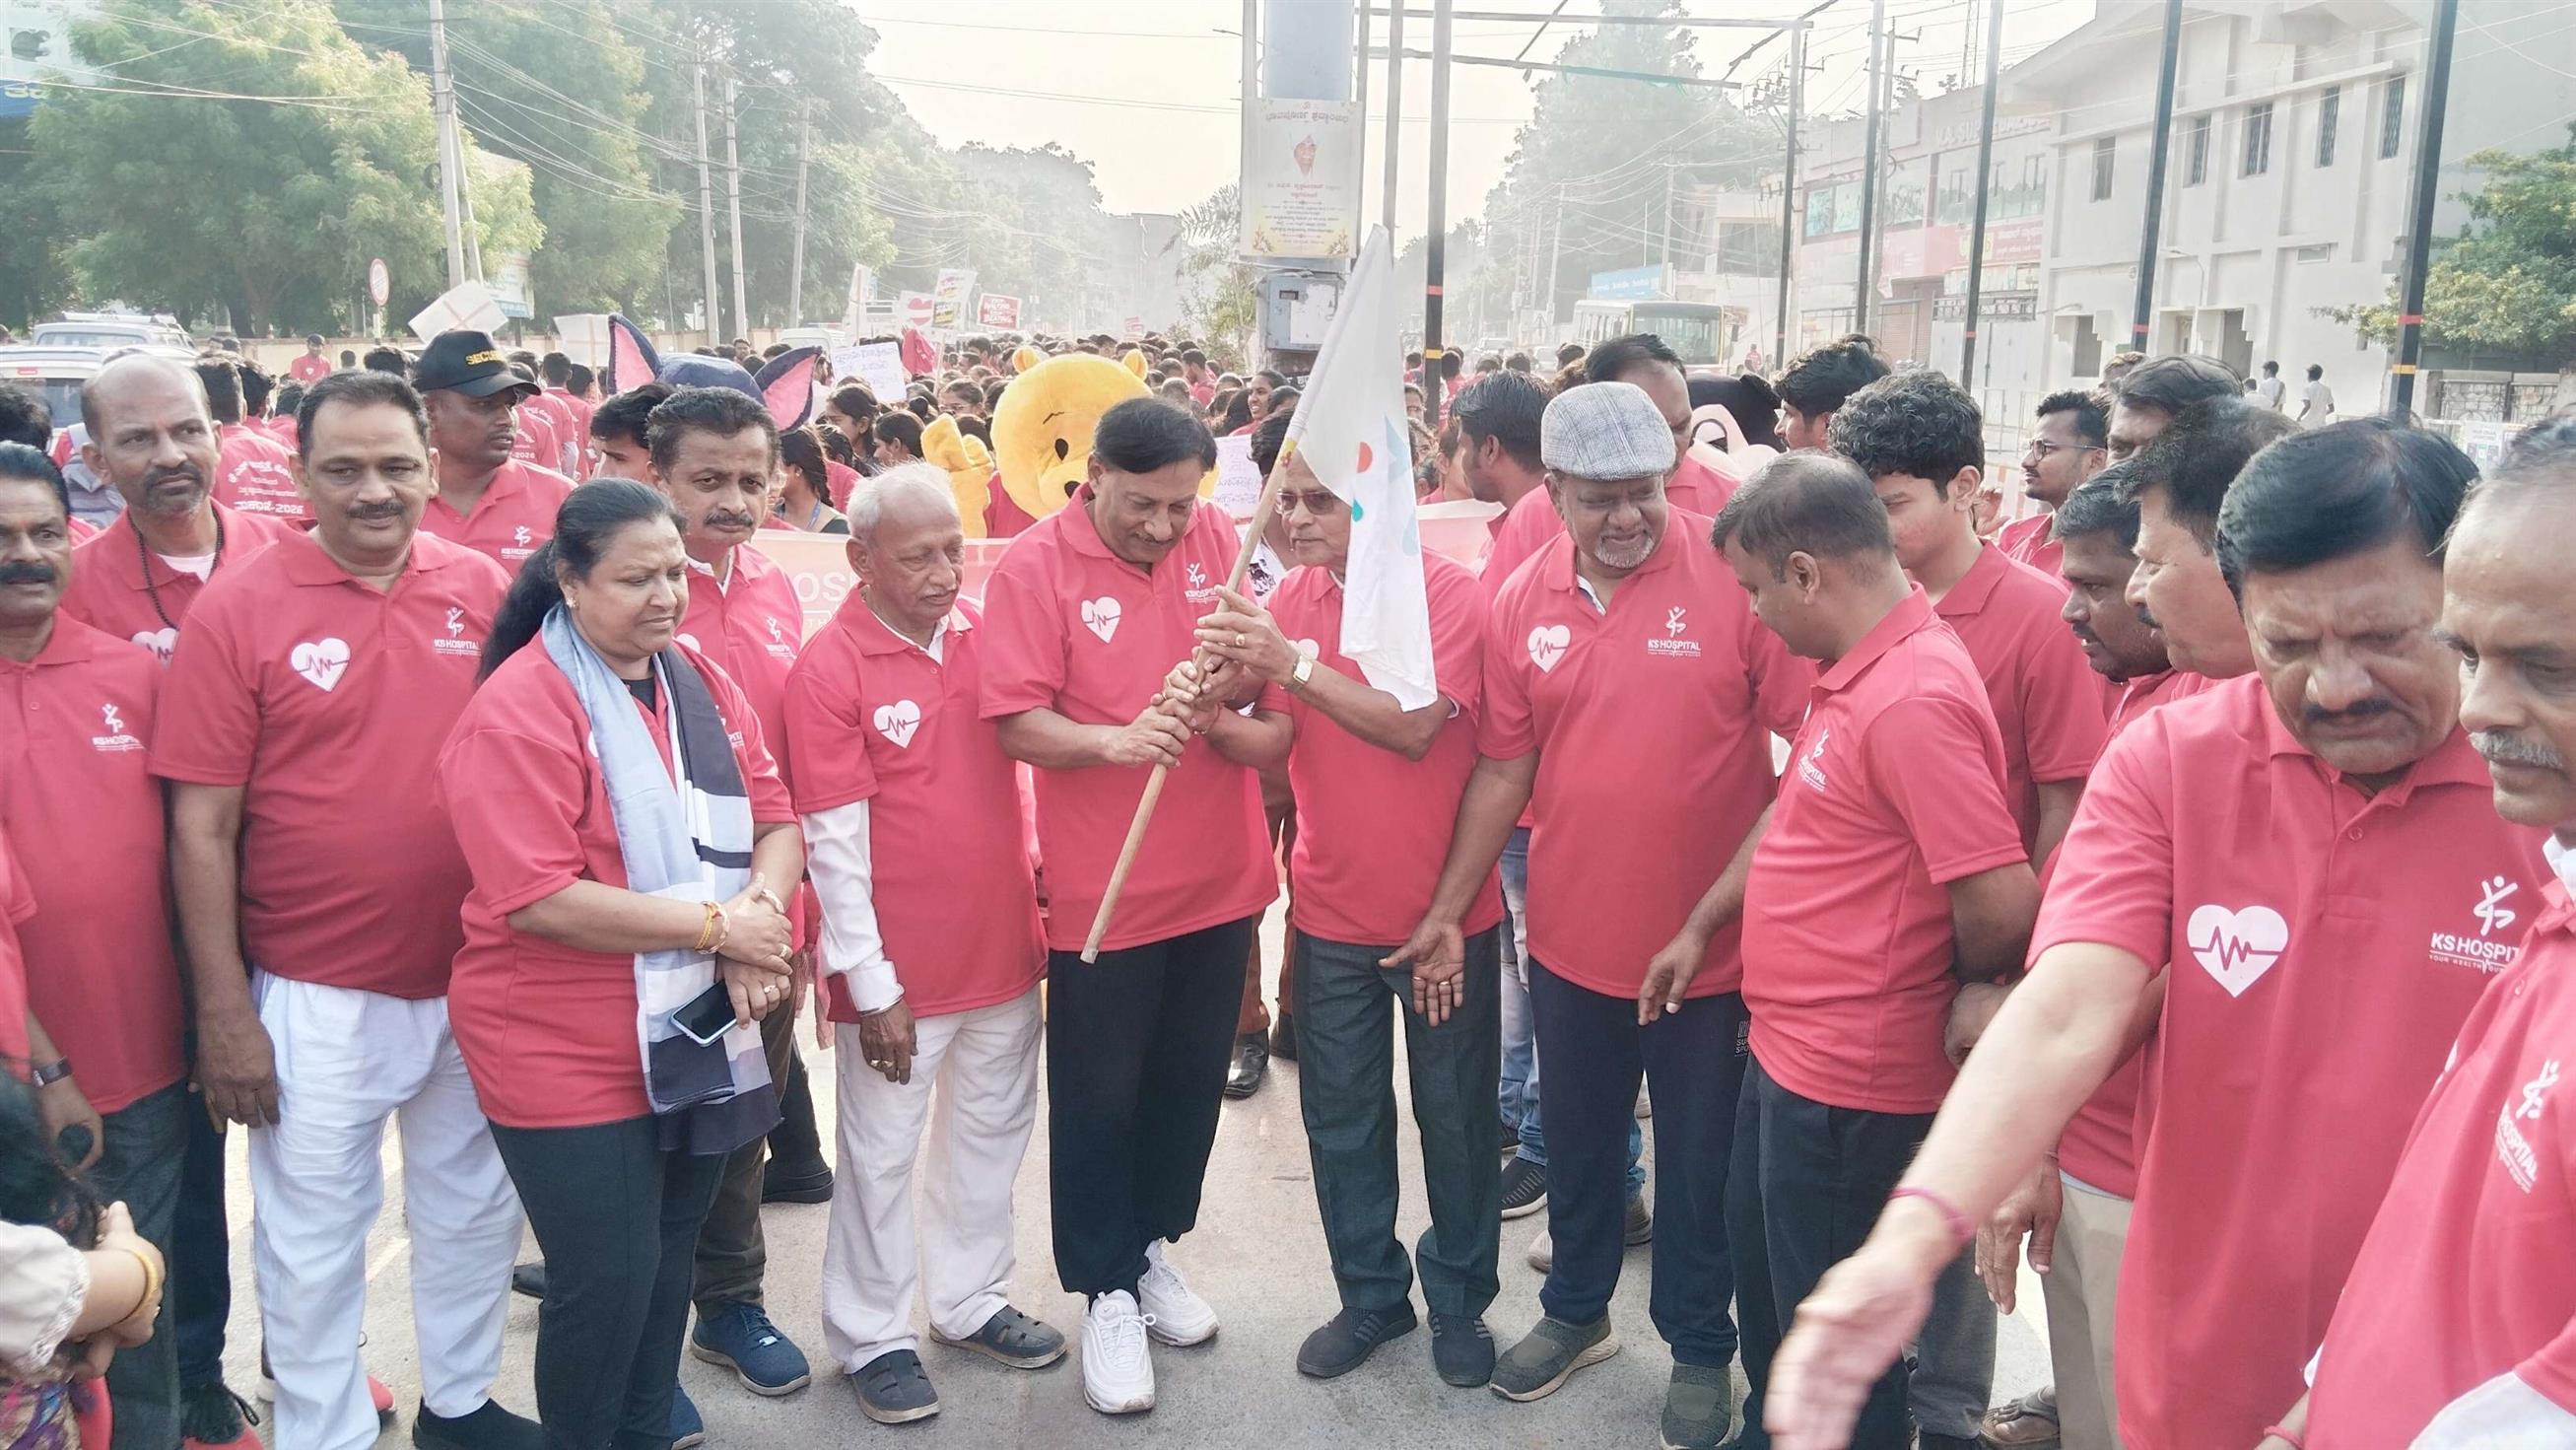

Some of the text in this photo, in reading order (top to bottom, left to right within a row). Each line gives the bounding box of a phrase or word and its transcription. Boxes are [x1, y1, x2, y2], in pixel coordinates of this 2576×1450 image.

[1660, 639, 1701, 651] HOSPITAL
[2430, 932, 2521, 962] KS HOSPIT
